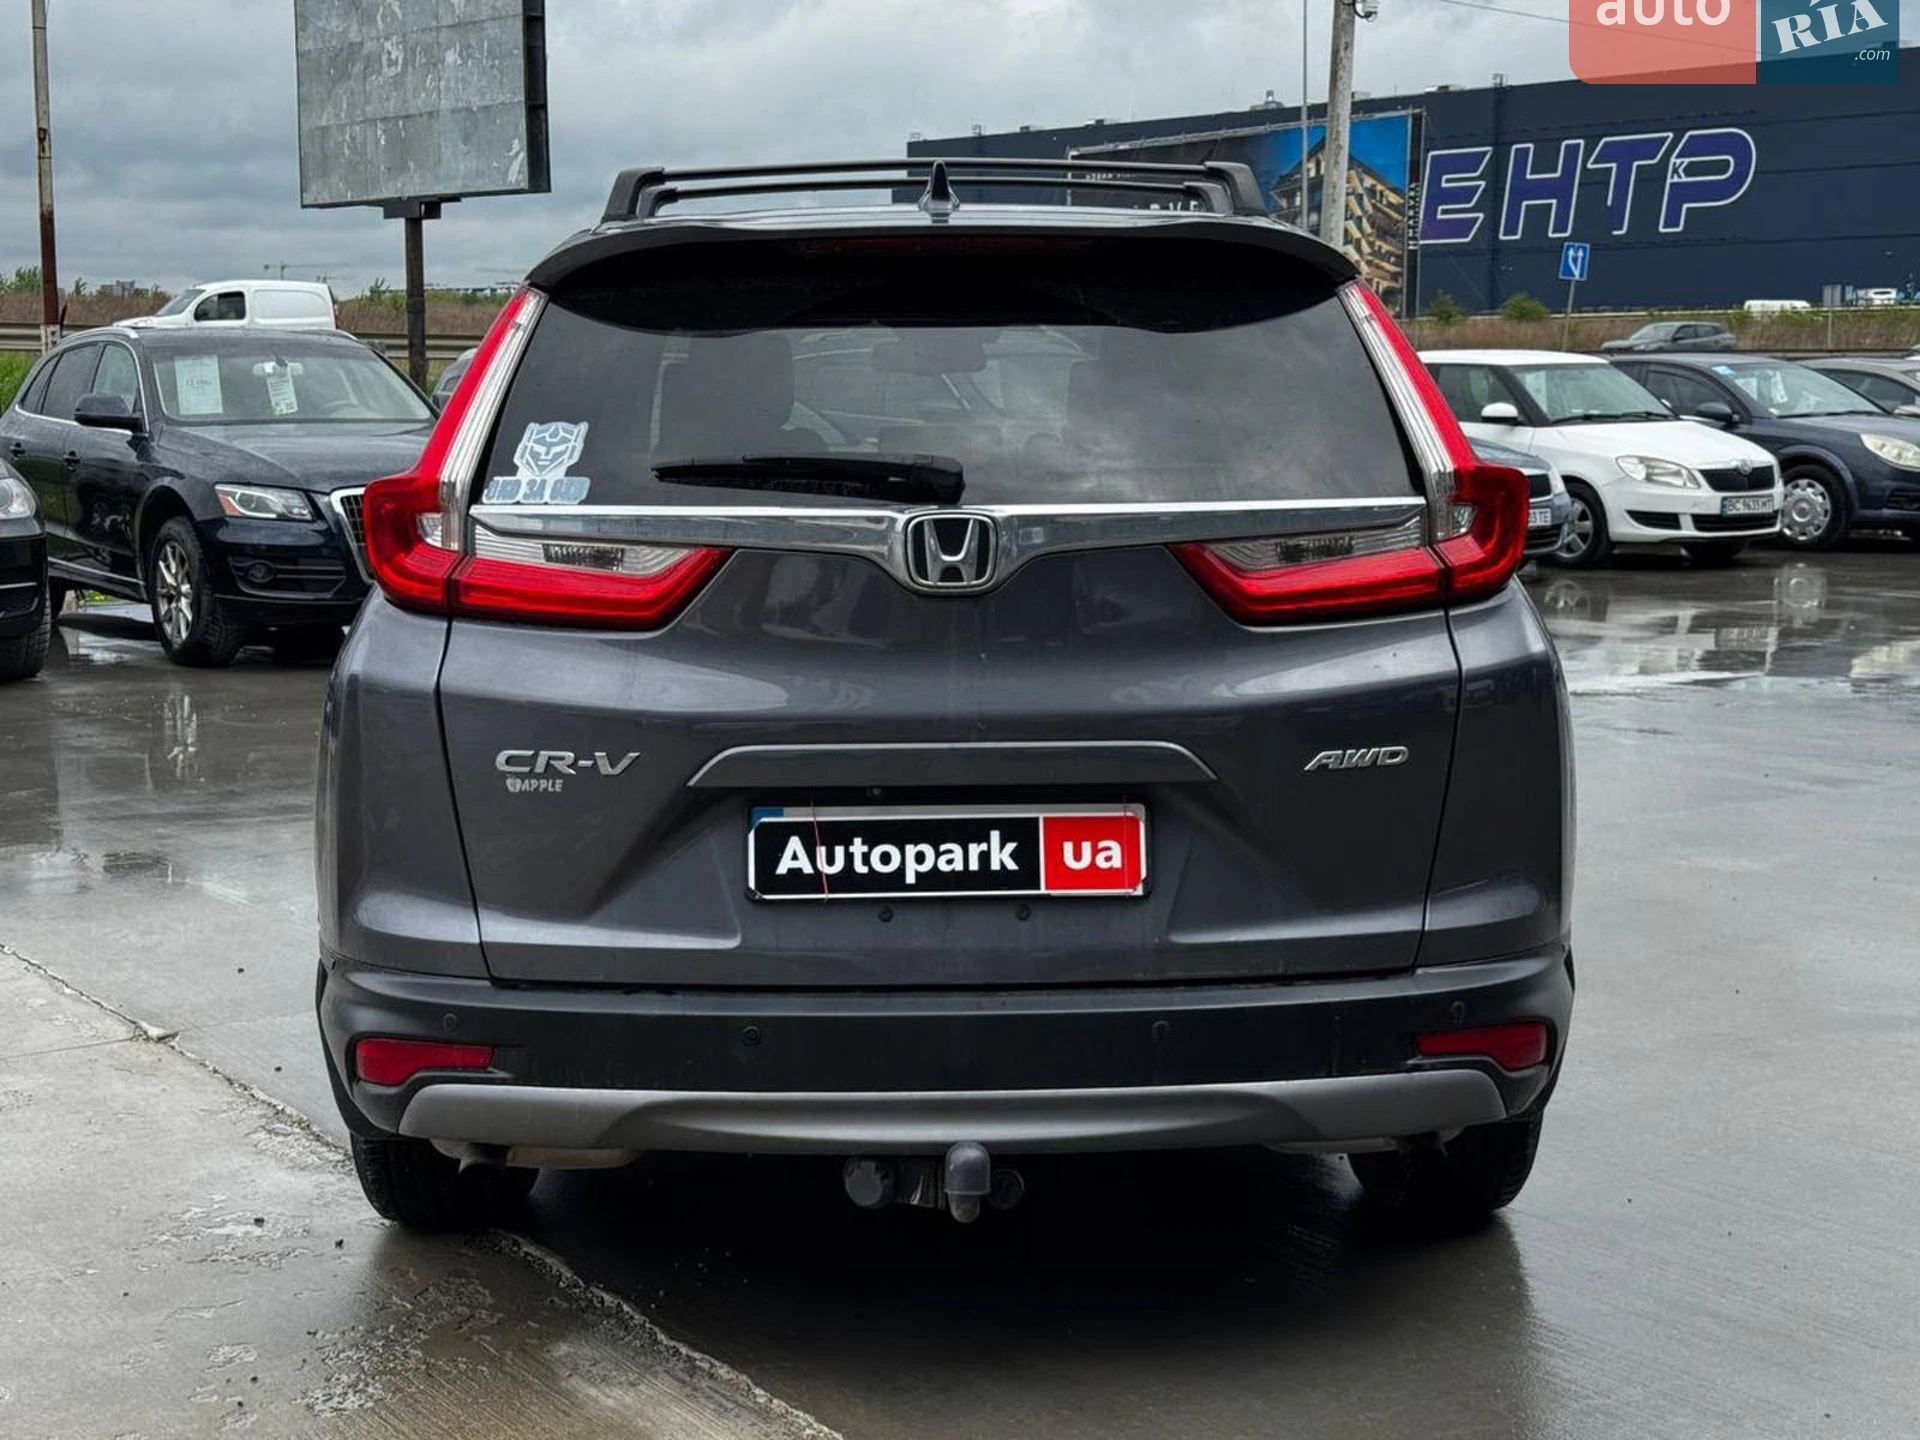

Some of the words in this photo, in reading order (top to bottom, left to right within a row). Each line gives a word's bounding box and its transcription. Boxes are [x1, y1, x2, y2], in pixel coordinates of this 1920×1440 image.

[495, 750, 641, 776] CR-V
[1304, 746, 1409, 771] AWD
[521, 779, 564, 792] APPLE
[775, 830, 1020, 884] Autopark
[1062, 839, 1123, 871] ua
